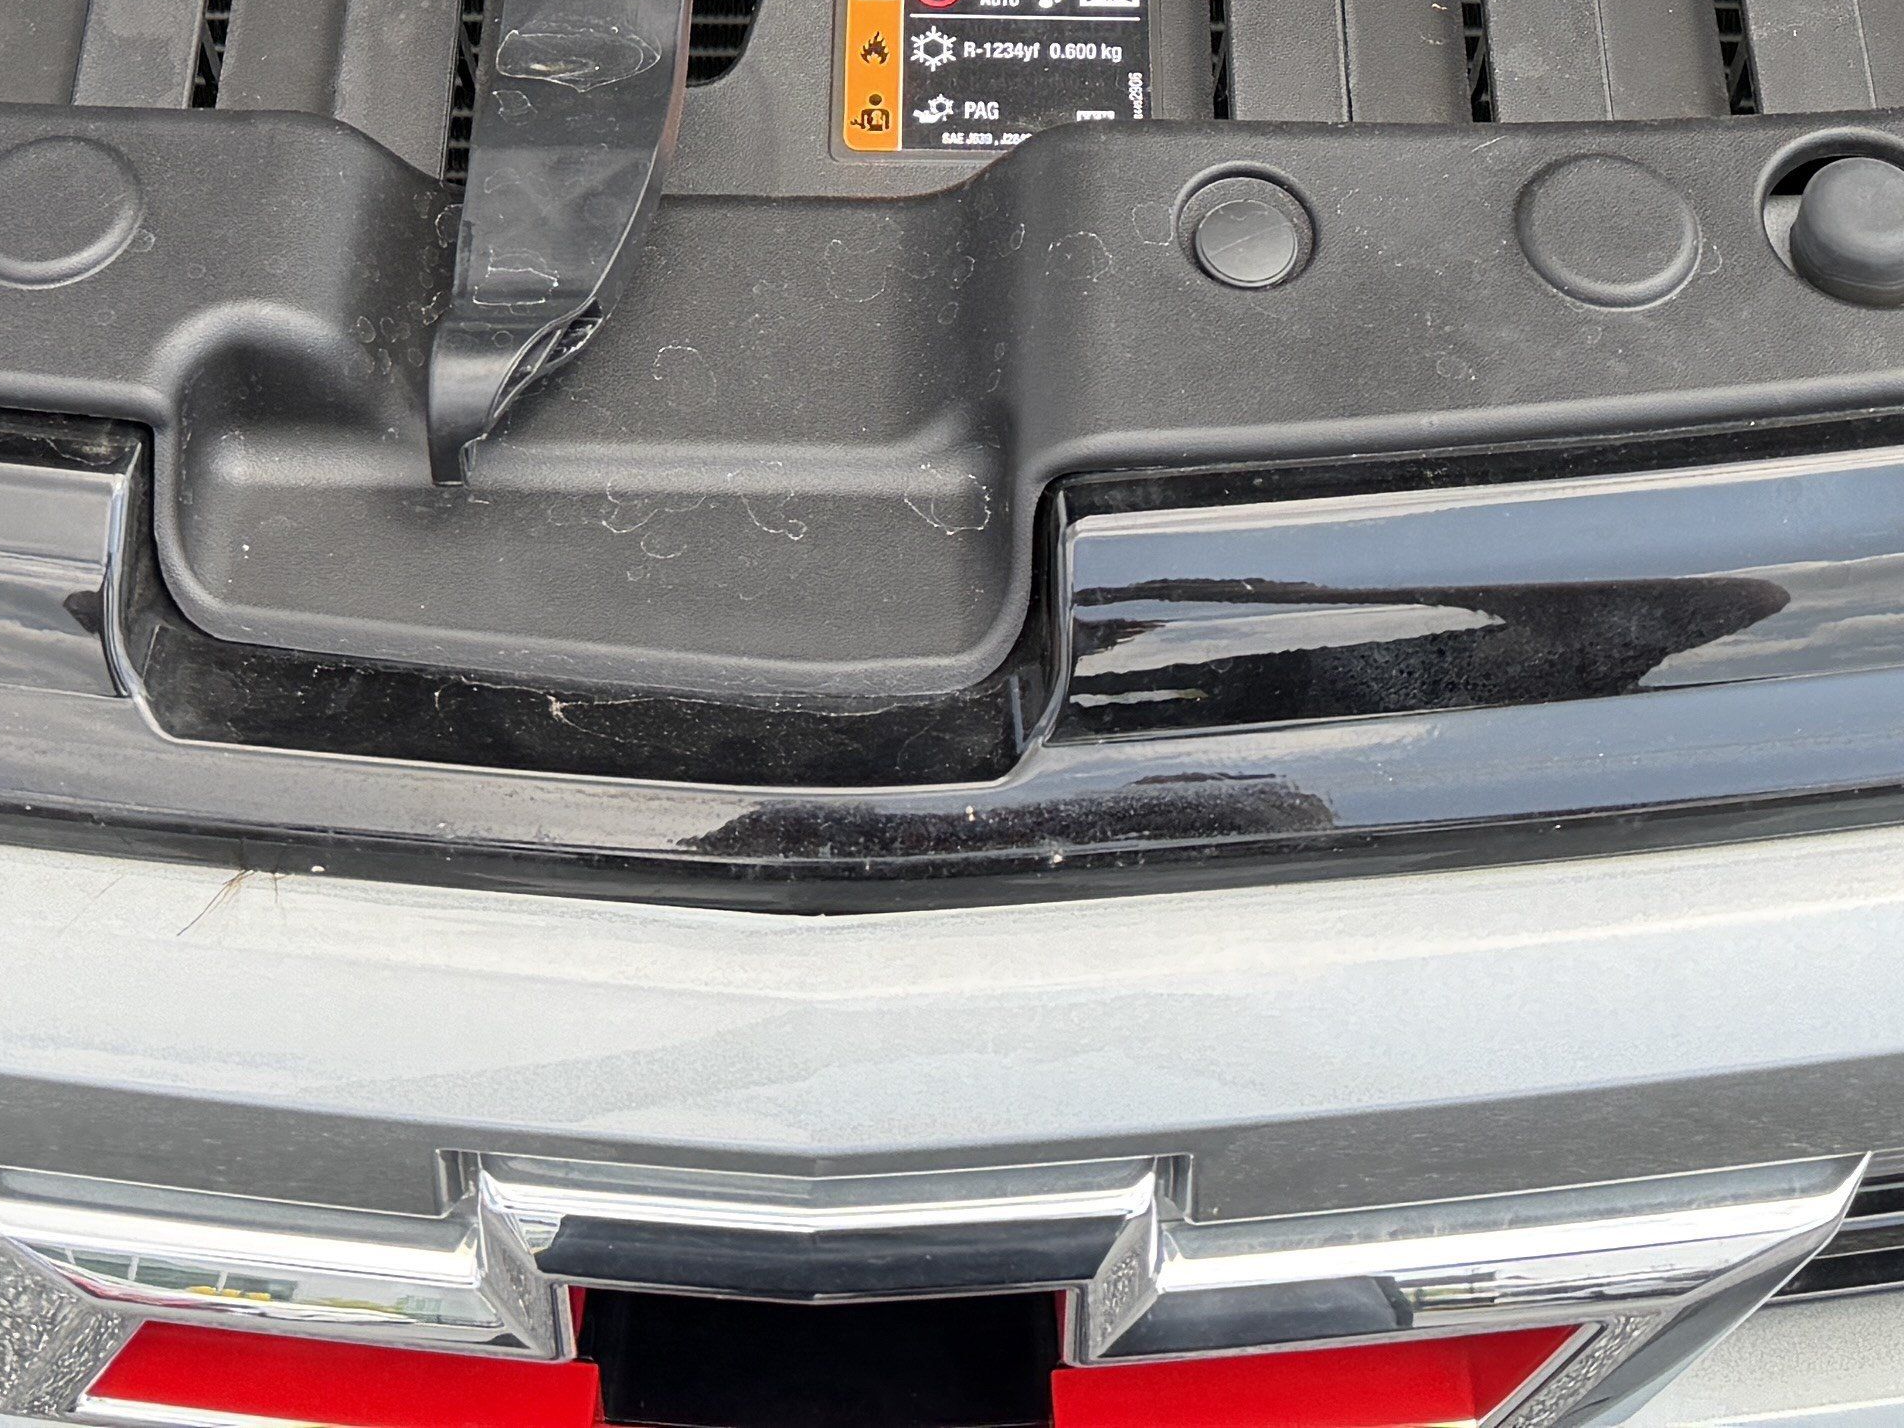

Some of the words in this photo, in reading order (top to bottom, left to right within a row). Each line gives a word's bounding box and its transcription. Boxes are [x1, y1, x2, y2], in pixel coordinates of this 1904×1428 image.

[963, 41, 1040, 62] R-1234yf
[1049, 42, 1096, 60] 0.600
[1101, 43, 1122, 63] kg
[964, 101, 999, 120] PAG
